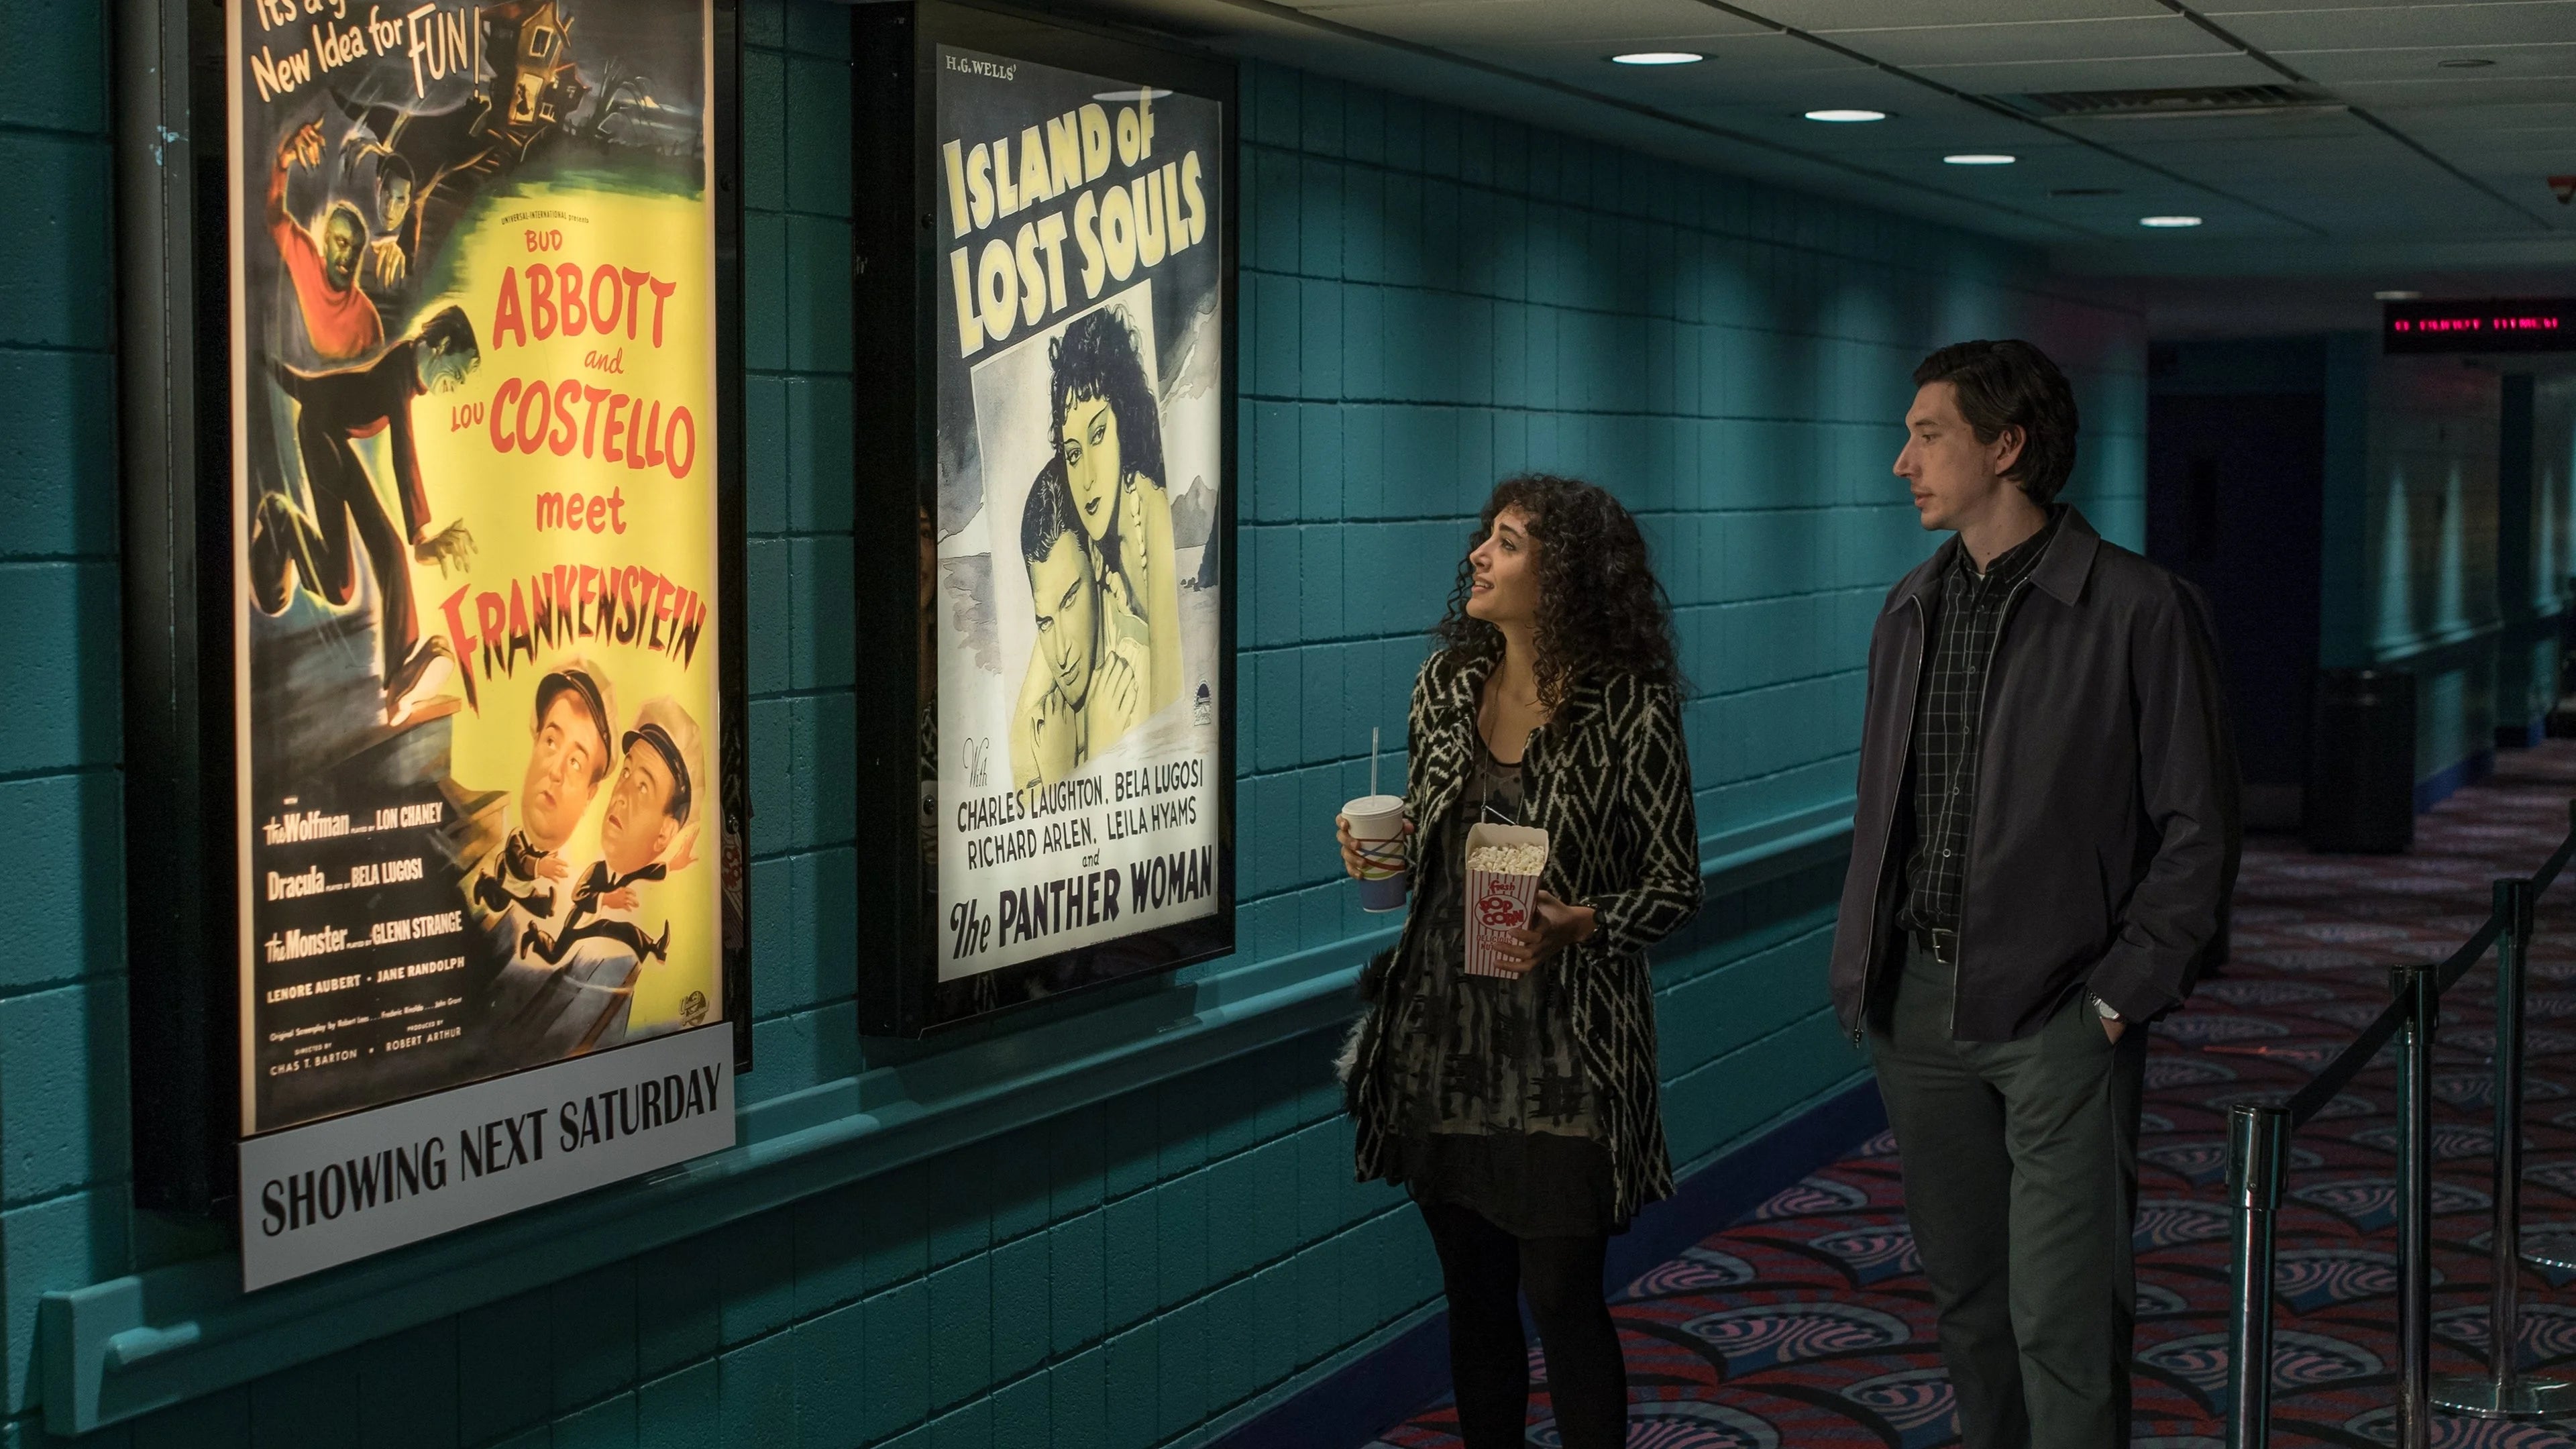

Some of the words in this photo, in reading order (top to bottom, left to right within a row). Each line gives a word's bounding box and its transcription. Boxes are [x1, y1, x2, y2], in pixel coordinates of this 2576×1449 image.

[251, 45, 311, 103] New
[312, 21, 368, 73] Idea
[369, 5, 403, 57] for
[407, 2, 480, 100] FUN!
[943, 103, 1112, 239] ISLAND
[524, 229, 563, 253] BUD
[568, 214, 590, 223] presents
[950, 211, 1068, 359] LOST
[1074, 150, 1206, 299] SOULS
[492, 262, 677, 350] ABBOTT
[584, 347, 625, 374] and
[451, 401, 484, 433] LOU
[490, 377, 696, 479] COSTELLO
[536, 486, 627, 535] meet
[439, 564, 707, 720] FRANKENSTEIN
[962, 737, 989, 788] With
[957, 788, 1025, 833] CHARLES
[1115, 769, 1151, 803] BELA
[1155, 759, 1203, 794] LUGOSI
[282, 810, 350, 843] Wolfman
[376, 807, 399, 831] LON
[400, 802, 443, 828] CHANEY
[967, 827, 1037, 870] RICHARD
[1107, 807, 1148, 841] LEILA
[1152, 796, 1197, 832] HYAMS
[268, 865, 325, 902] Dracula
[351, 864, 380, 888] BELA
[382, 858, 423, 883] LUGOSI
[1082, 848, 1100, 868] and
[950, 899, 991, 960] The
[999, 868, 1121, 948] PANTHER
[1130, 844, 1213, 914] WOMAN
[1479, 897, 1513, 914] POP
[1490, 880, 1515, 894] fresh
[285, 924, 349, 961] Monster
[372, 919, 411, 945] GLENN
[411, 911, 463, 939] STRANGE
[1483, 909, 1524, 927] CORN
[267, 981, 313, 1004] LENORE
[315, 973, 362, 995] AUBERT
[377, 966, 405, 983] JANE
[406, 956, 466, 978] RANDOLPH
[269, 1061, 301, 1076] CHAS
[314, 1049, 358, 1067] BARTON
[386, 1035, 423, 1053] ROBERT
[426, 1026, 462, 1044] ARTHUR
[261, 1136, 447, 1237] SHOWING
[460, 1108, 548, 1182] NEXT
[559, 1062, 721, 1152] SATURDAY
